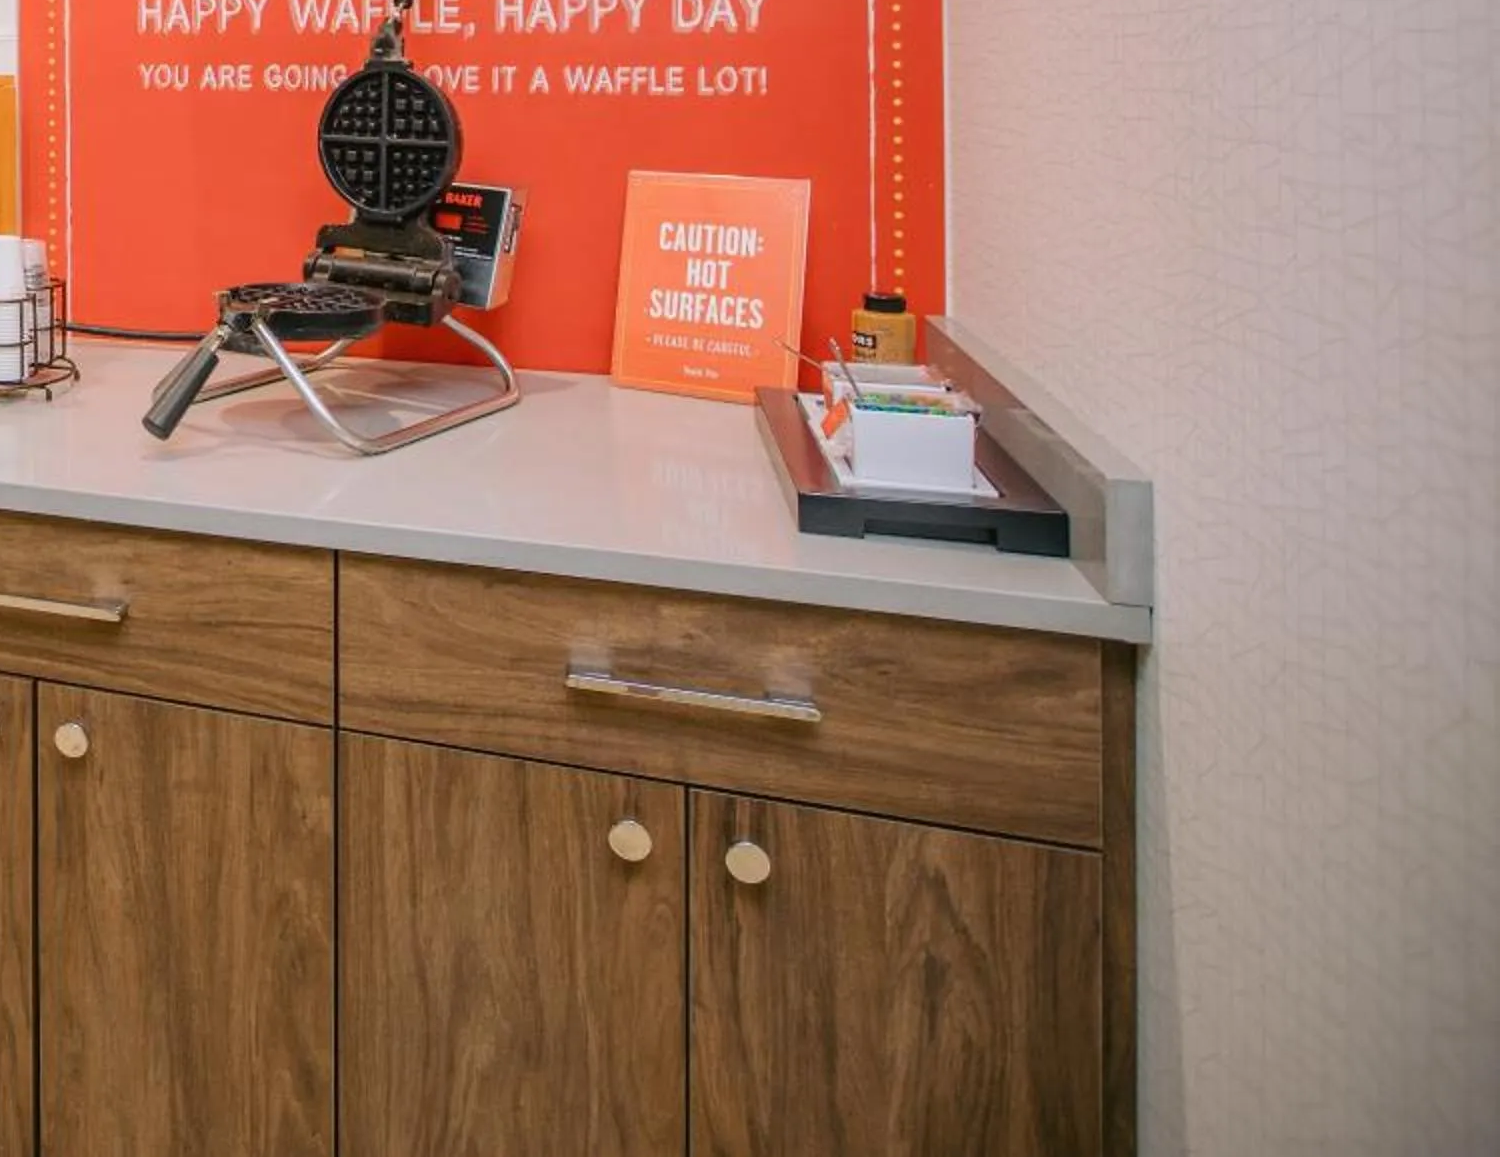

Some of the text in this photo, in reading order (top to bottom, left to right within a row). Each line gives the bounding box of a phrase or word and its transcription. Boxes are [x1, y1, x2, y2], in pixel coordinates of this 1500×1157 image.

[139, 63, 768, 95] YOU ARE GOING OVE IT A WAFFLE LOT!
[659, 221, 764, 258] CAUTION:
[686, 258, 732, 289] HOT
[650, 289, 764, 329] SURFACES
